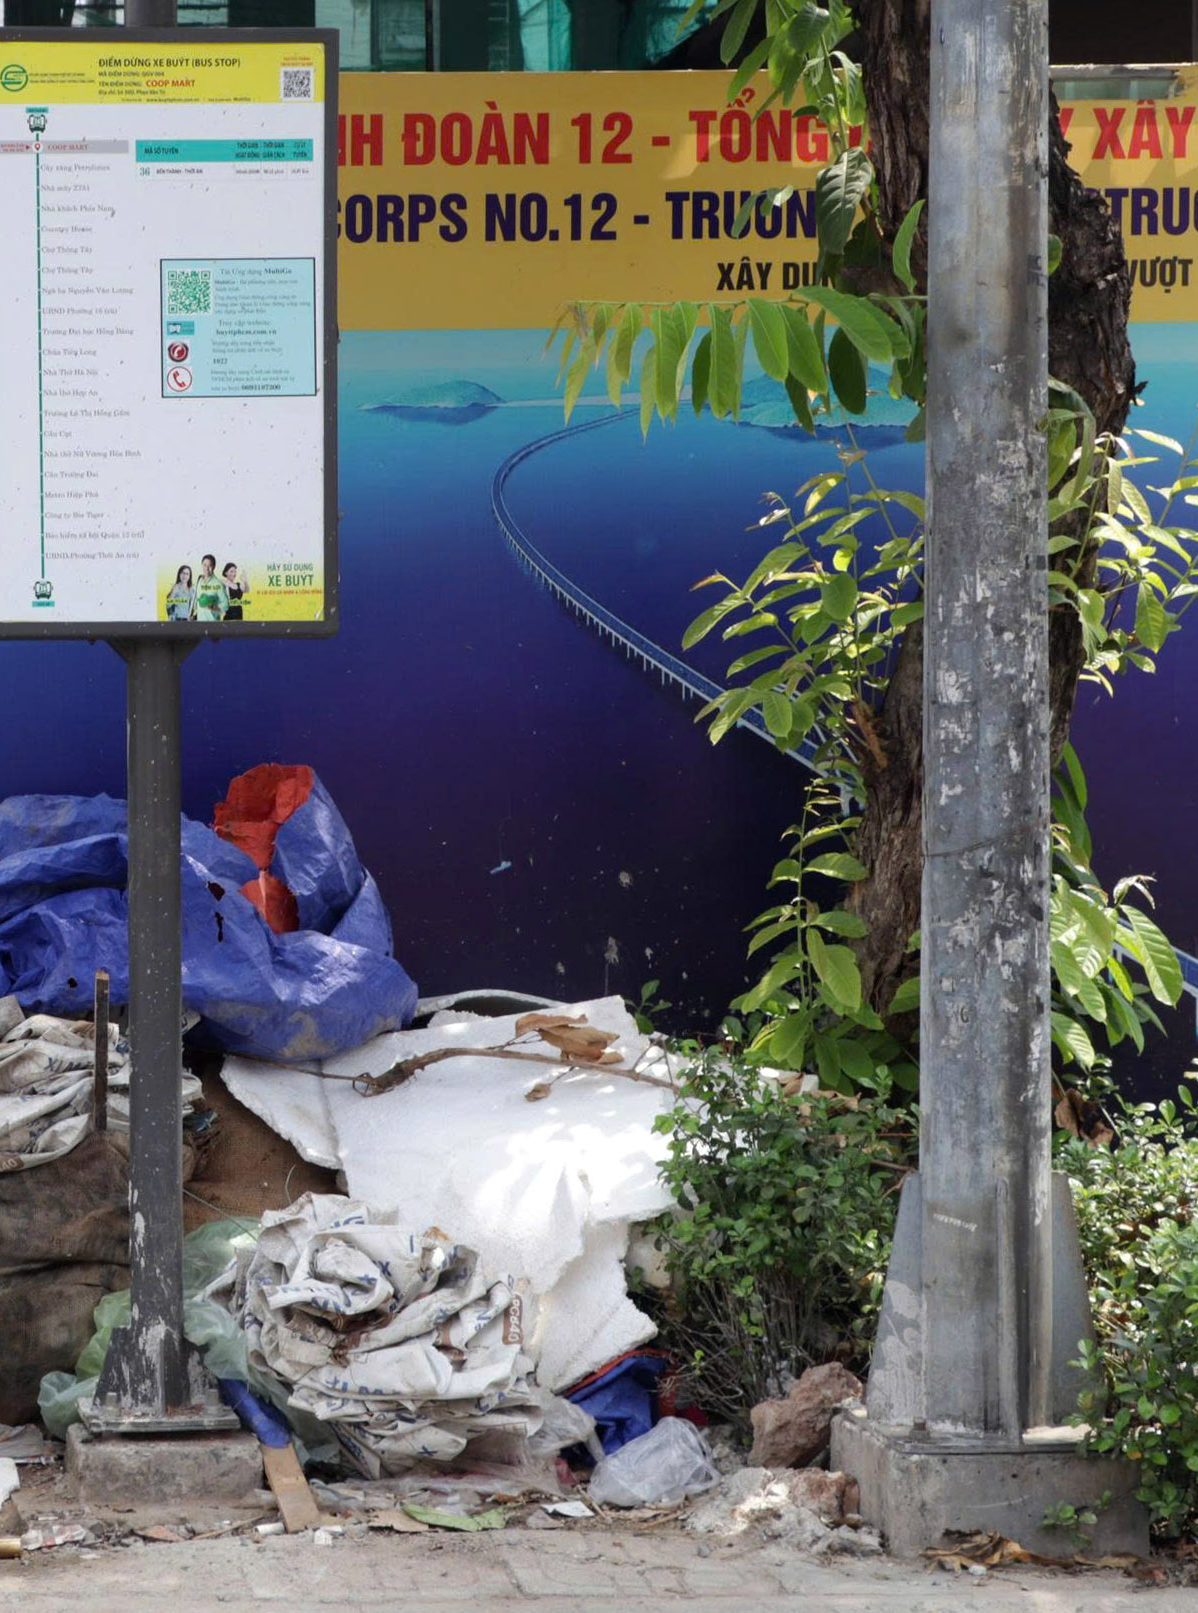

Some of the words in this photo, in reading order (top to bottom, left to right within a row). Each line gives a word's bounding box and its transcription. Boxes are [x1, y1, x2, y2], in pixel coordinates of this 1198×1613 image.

[98, 56, 122, 67] ĐIỂM
[123, 56, 151, 67] DỪNG
[153, 58, 164, 67] XE
[166, 56, 189, 67] BUÝT
[192, 58, 212, 68] (BUS
[214, 58, 241, 68] STOP)
[402, 101, 550, 165] ĐOÀN
[571, 112, 633, 164] 12
[652, 135, 670, 147] -
[689, 88, 829, 165] TỔNG
[1092, 100, 1196, 160] XÂY
[139, 167, 151, 176] 36
[338, 193, 468, 243] ORPS
[484, 192, 618, 242] NO.12
[633, 214, 650, 225] -
[1085, 187, 1198, 236] TRU
[716, 255, 773, 291] XÂY
[268, 575, 281, 587] XE
[285, 572, 314, 587] BUÝT
